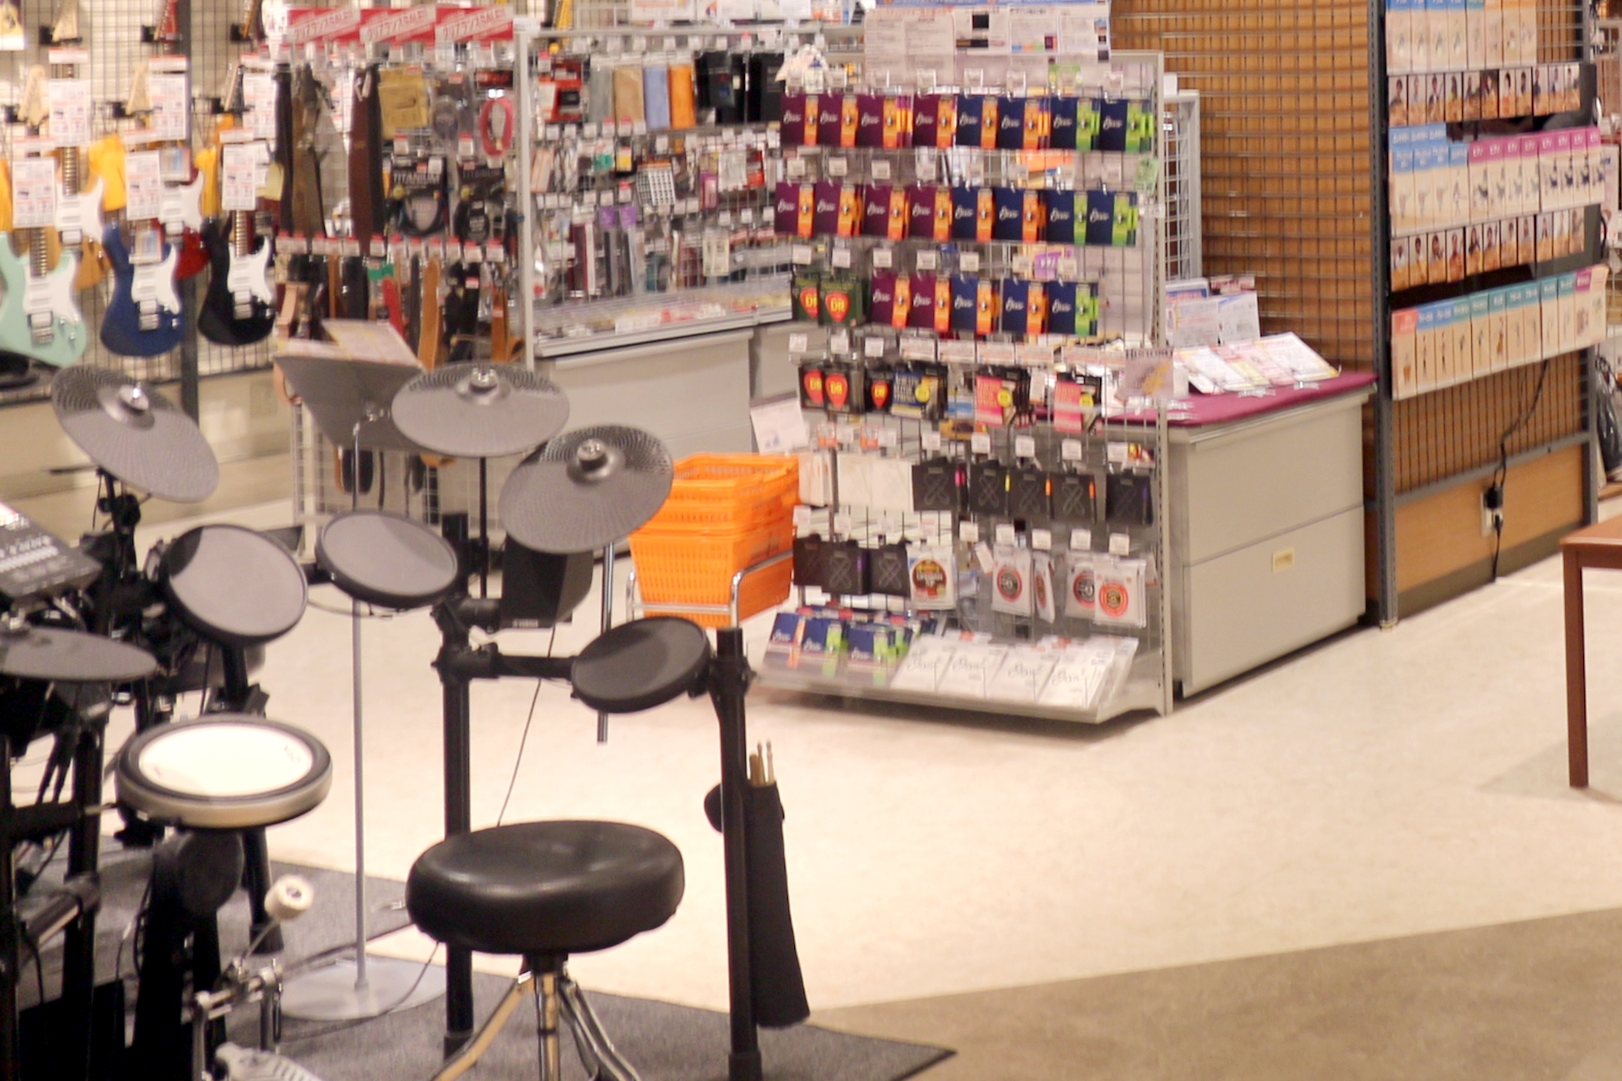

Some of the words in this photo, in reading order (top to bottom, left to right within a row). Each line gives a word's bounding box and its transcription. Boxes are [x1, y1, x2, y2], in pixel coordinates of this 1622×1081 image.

[393, 173, 440, 184] TITANIUM
[830, 298, 845, 312] DR
[830, 382, 843, 395] DR
